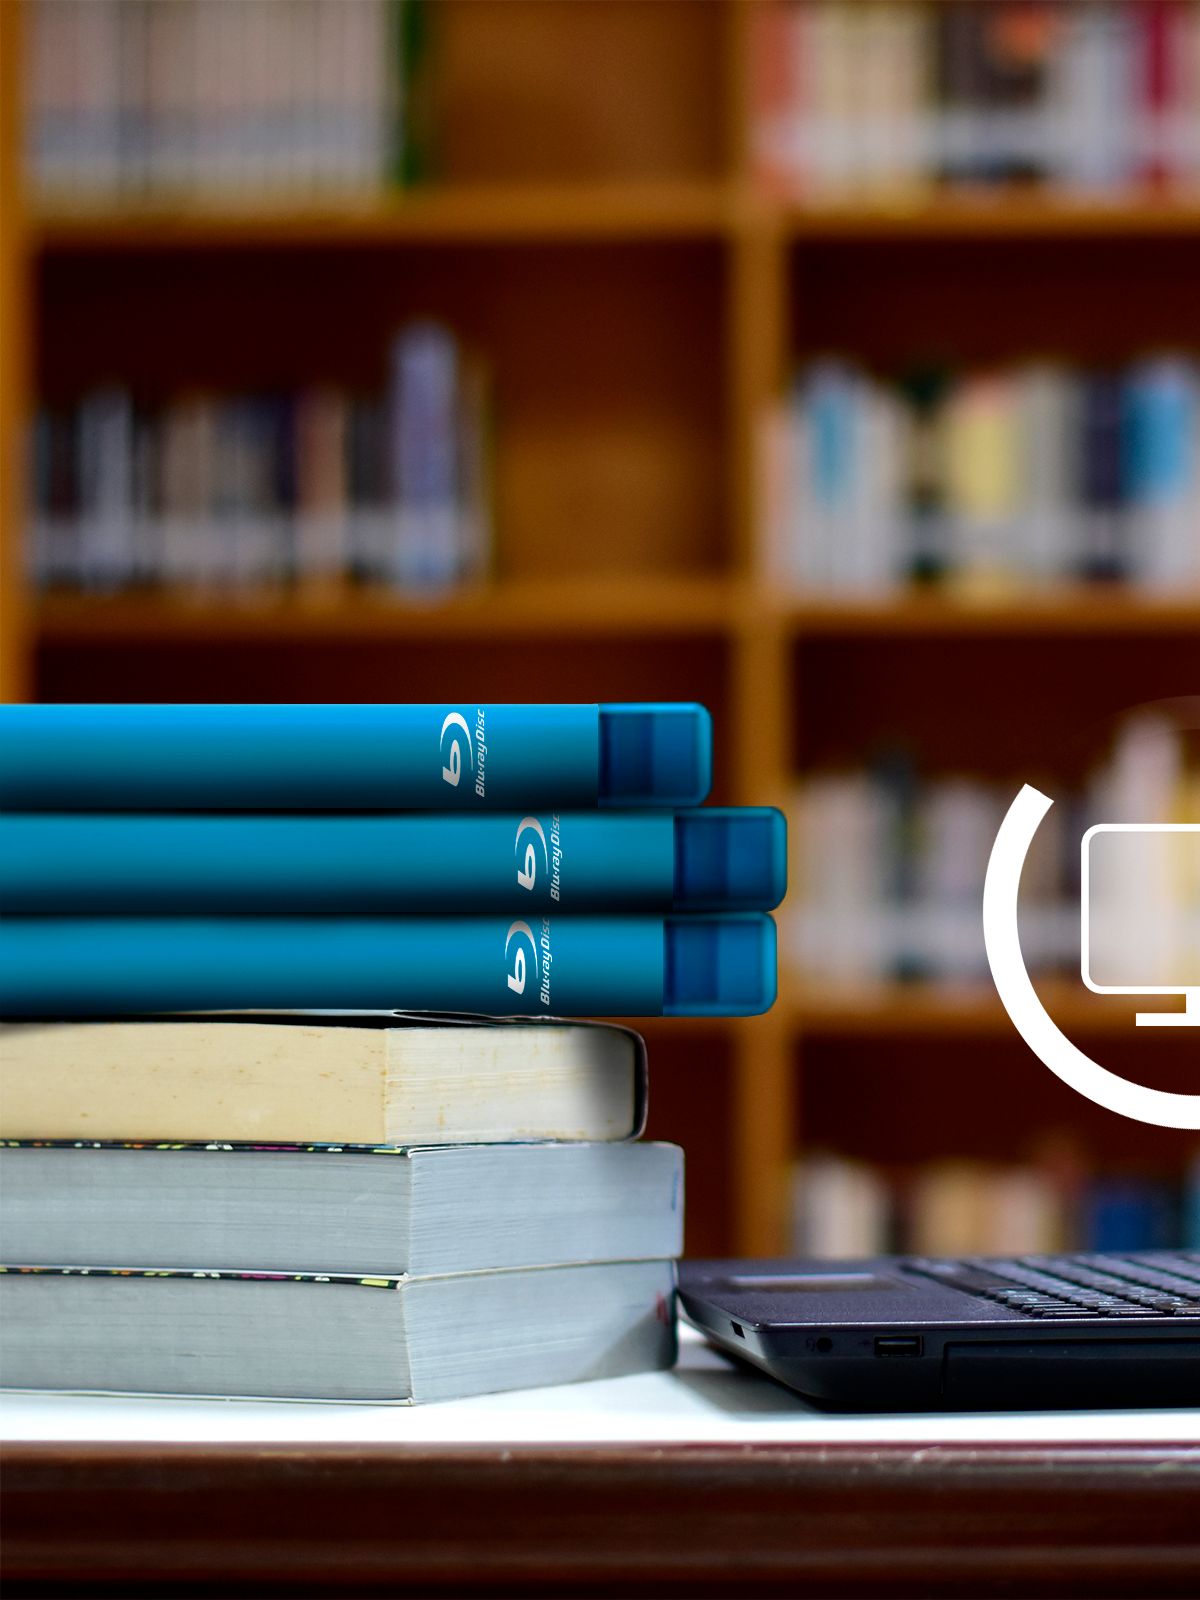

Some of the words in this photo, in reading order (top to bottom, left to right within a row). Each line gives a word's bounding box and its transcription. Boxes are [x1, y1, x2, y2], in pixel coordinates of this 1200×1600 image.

[476, 708, 484, 742] Disc
[476, 743, 487, 797] Blu-ray
[551, 811, 560, 846] Disc
[551, 847, 562, 901] Blu-ray
[541, 916, 550, 950] Disc
[541, 950, 552, 1006] Blu-ray
